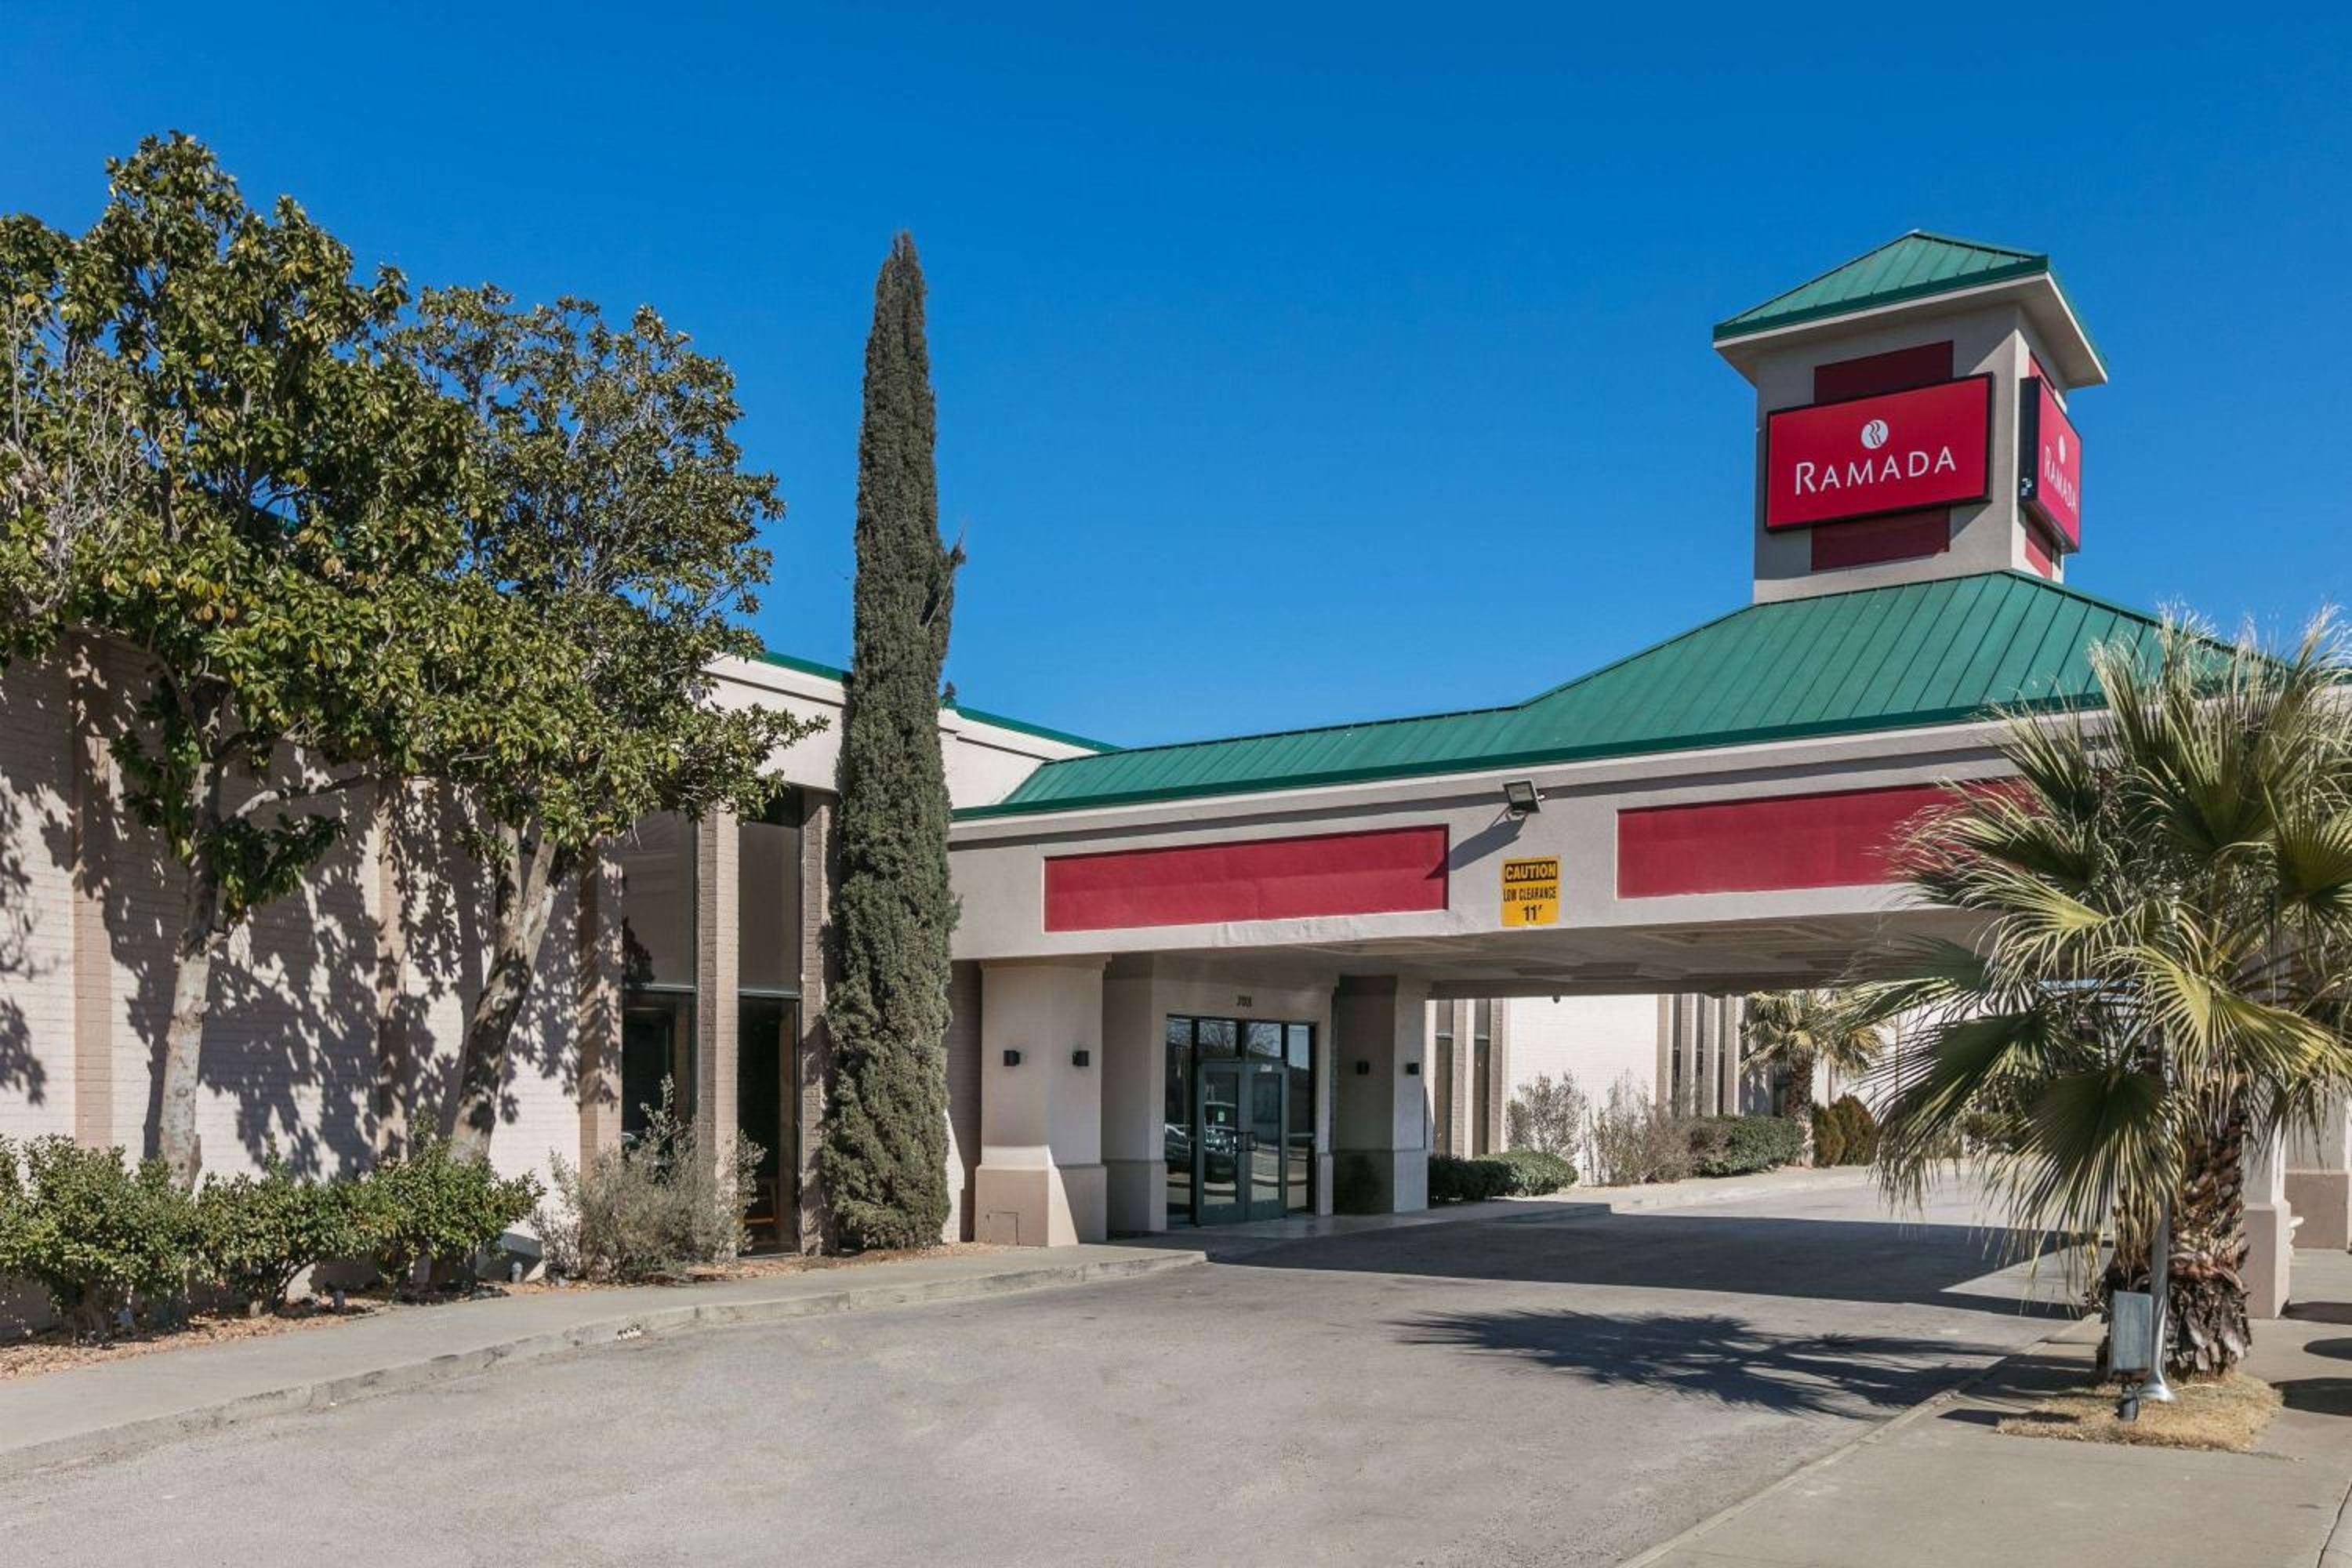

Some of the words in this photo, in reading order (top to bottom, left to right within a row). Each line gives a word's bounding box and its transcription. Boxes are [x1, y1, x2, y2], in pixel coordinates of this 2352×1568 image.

[1795, 445, 1957, 496] RAMADA
[1505, 863, 1556, 880] CAUTION
[1503, 888, 1518, 902] LOW
[1519, 885, 1556, 901] CLEARANCE
